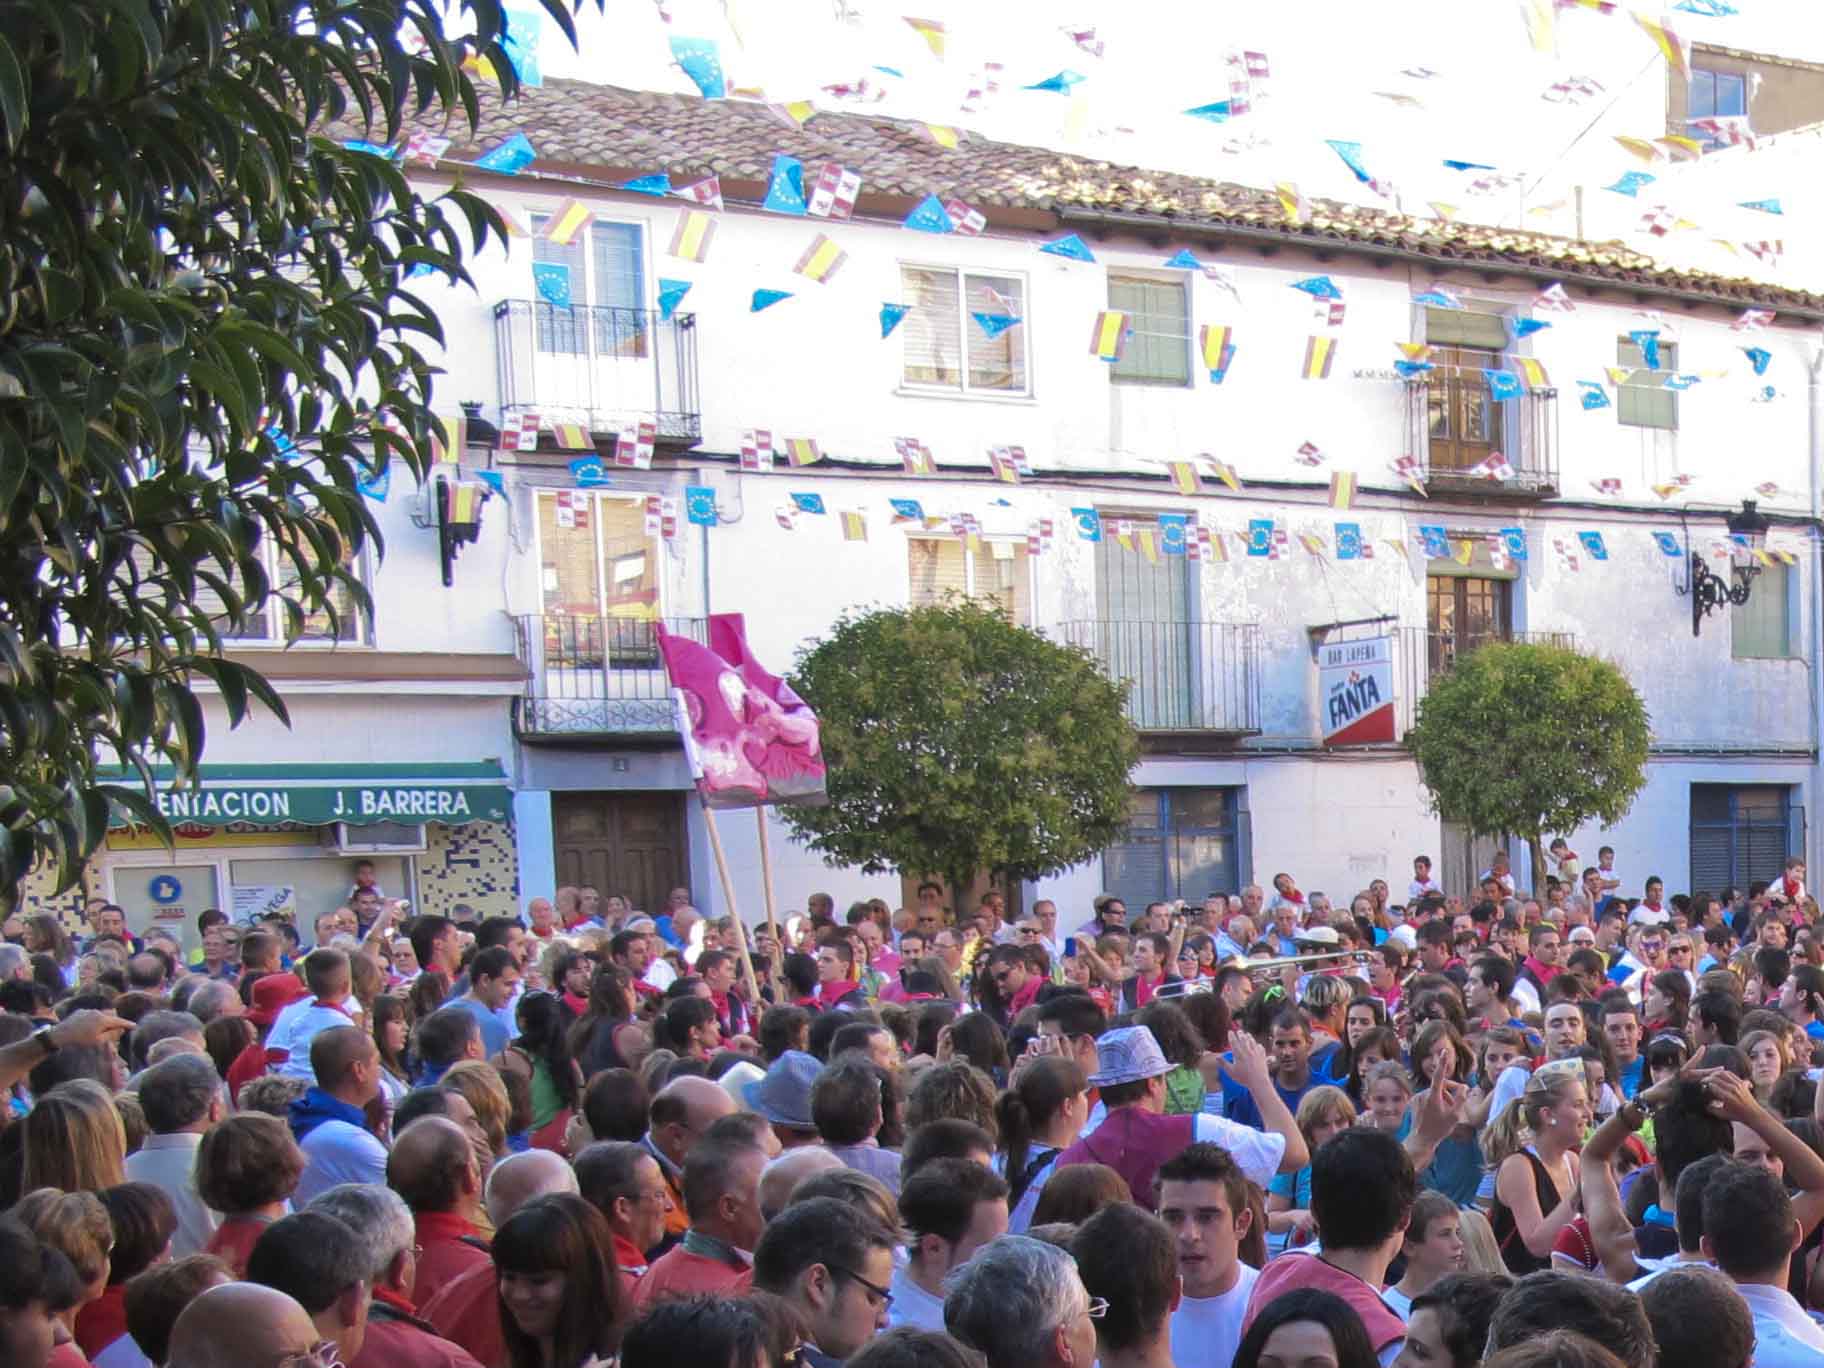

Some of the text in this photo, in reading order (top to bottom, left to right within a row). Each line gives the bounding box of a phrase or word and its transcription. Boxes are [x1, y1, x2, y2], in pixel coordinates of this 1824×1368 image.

[1328, 648, 1343, 665] BAR
[1328, 674, 1381, 729] FANTA
[126, 790, 470, 817] ENTACION J. BARRERA
